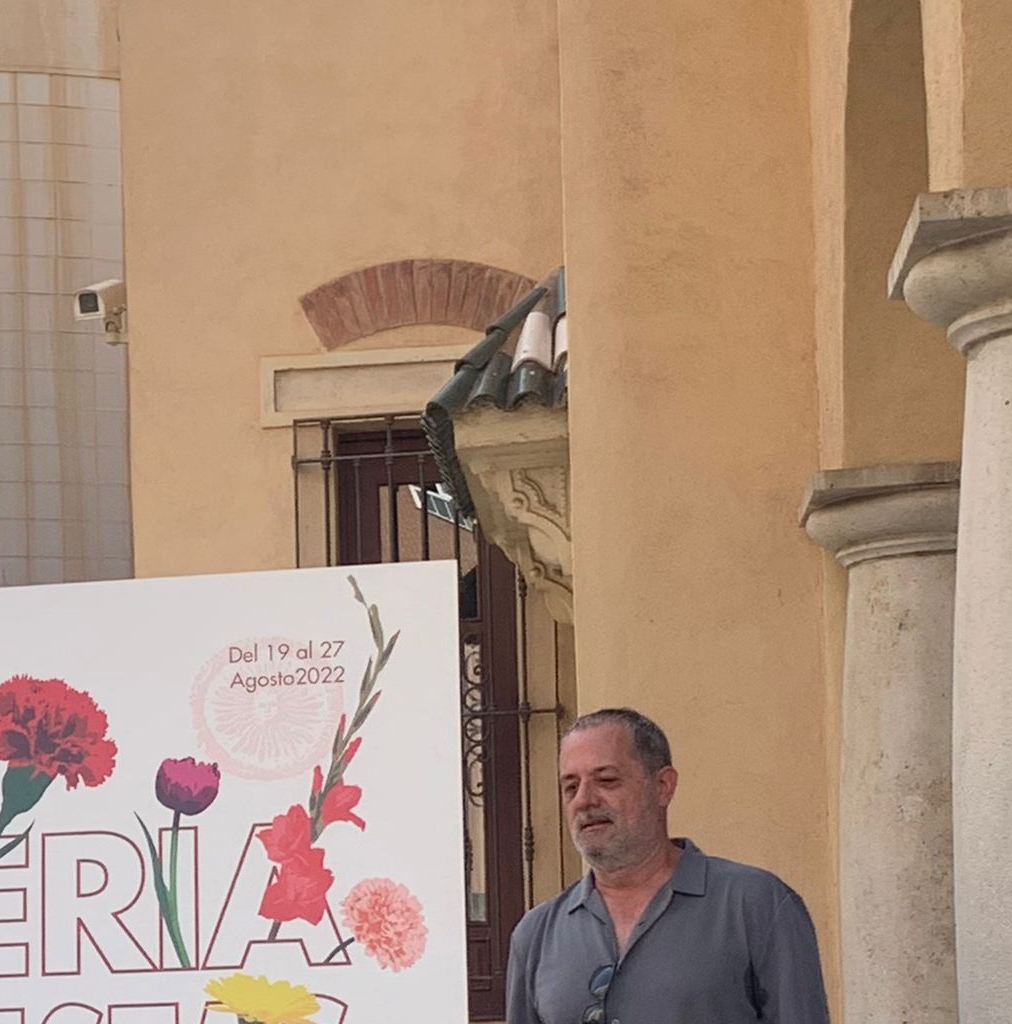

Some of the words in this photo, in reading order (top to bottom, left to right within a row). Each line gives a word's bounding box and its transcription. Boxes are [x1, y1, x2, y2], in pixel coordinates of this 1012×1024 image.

[229, 643, 258, 663] Del
[268, 643, 290, 661] 19
[296, 640, 313, 660] al
[320, 640, 345, 659] 27
